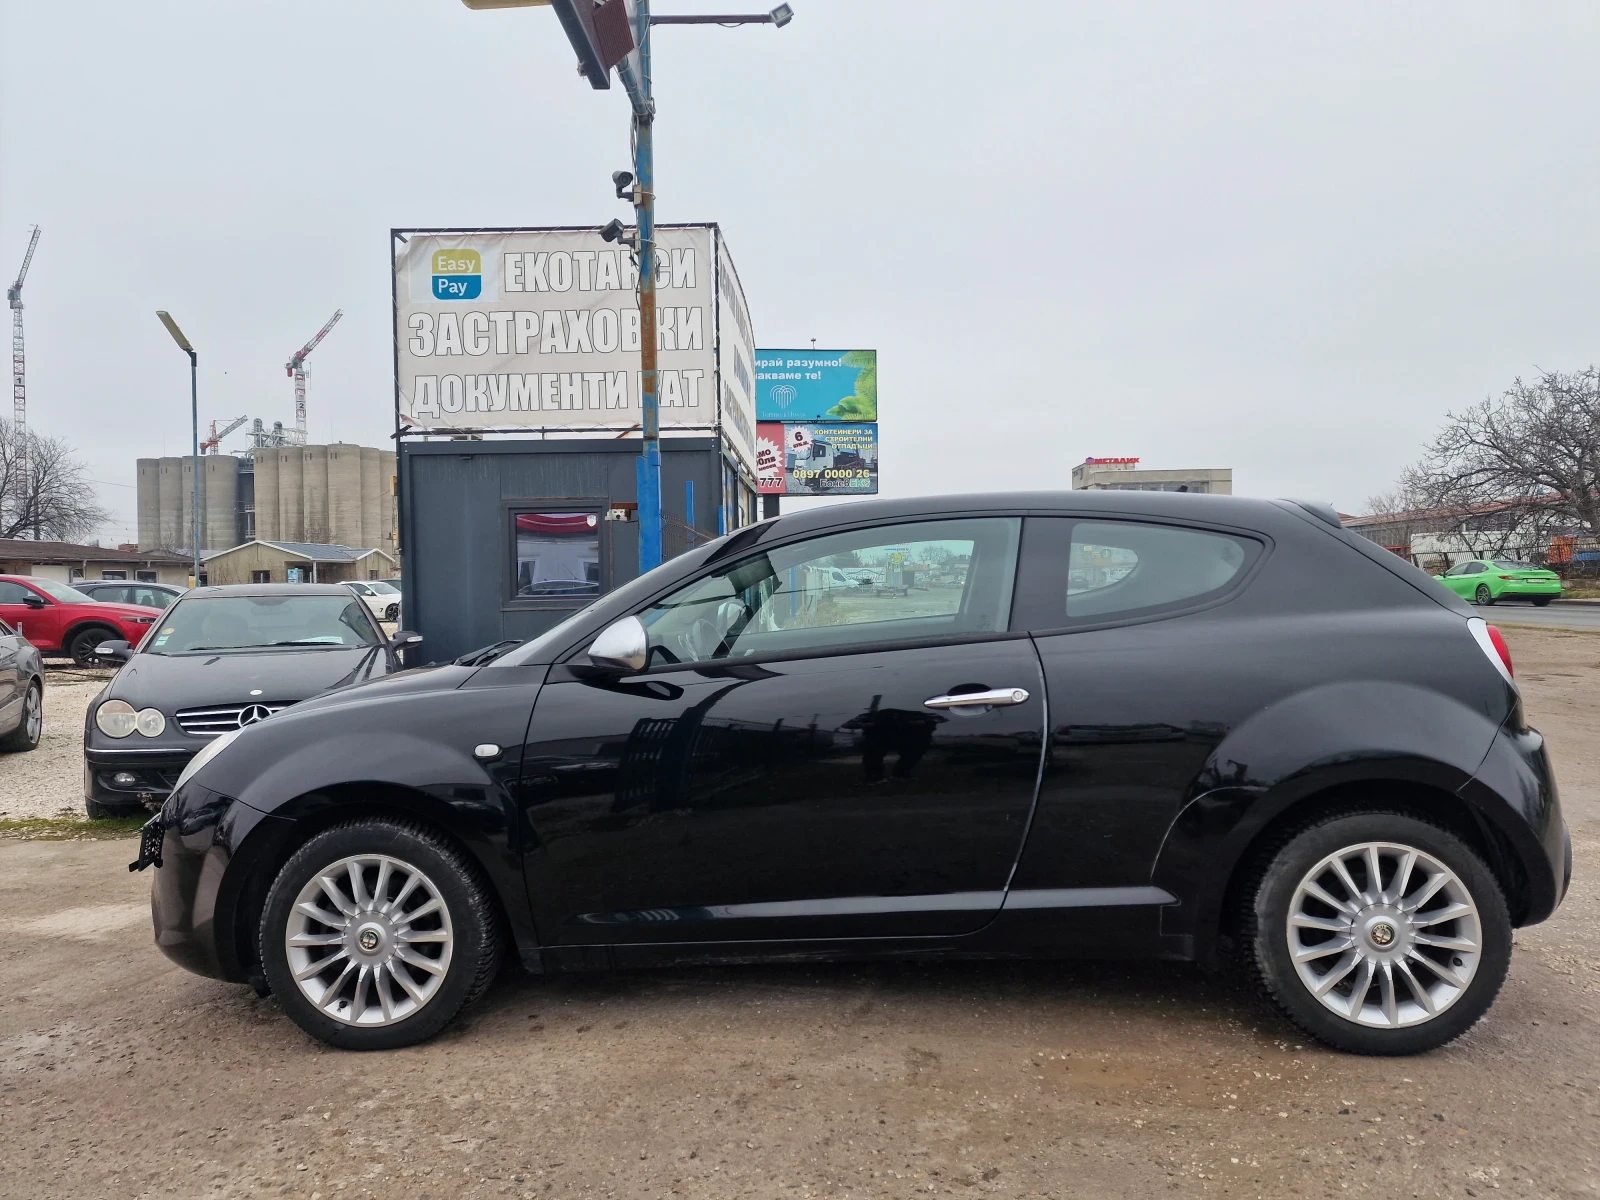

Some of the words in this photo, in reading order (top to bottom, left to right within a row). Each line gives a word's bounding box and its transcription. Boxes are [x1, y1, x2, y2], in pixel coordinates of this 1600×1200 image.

[437, 255, 476, 273] Easy
[437, 279, 468, 295] Pay
[407, 306, 704, 358] ЗАСТРАХОВКИ
[755, 357, 783, 369] ирай
[787, 358, 842, 369] разумно!
[755, 372, 802, 380] акваме
[805, 371, 822, 380] те!
[410, 371, 629, 419] ДОКУМЕНТИ
[794, 431, 804, 442] 6
[756, 449, 771, 459] МО
[793, 469, 821, 479] 0897
[824, 469, 853, 479] 0000
[856, 469, 871, 479] 26
[759, 476, 784, 488] 777
